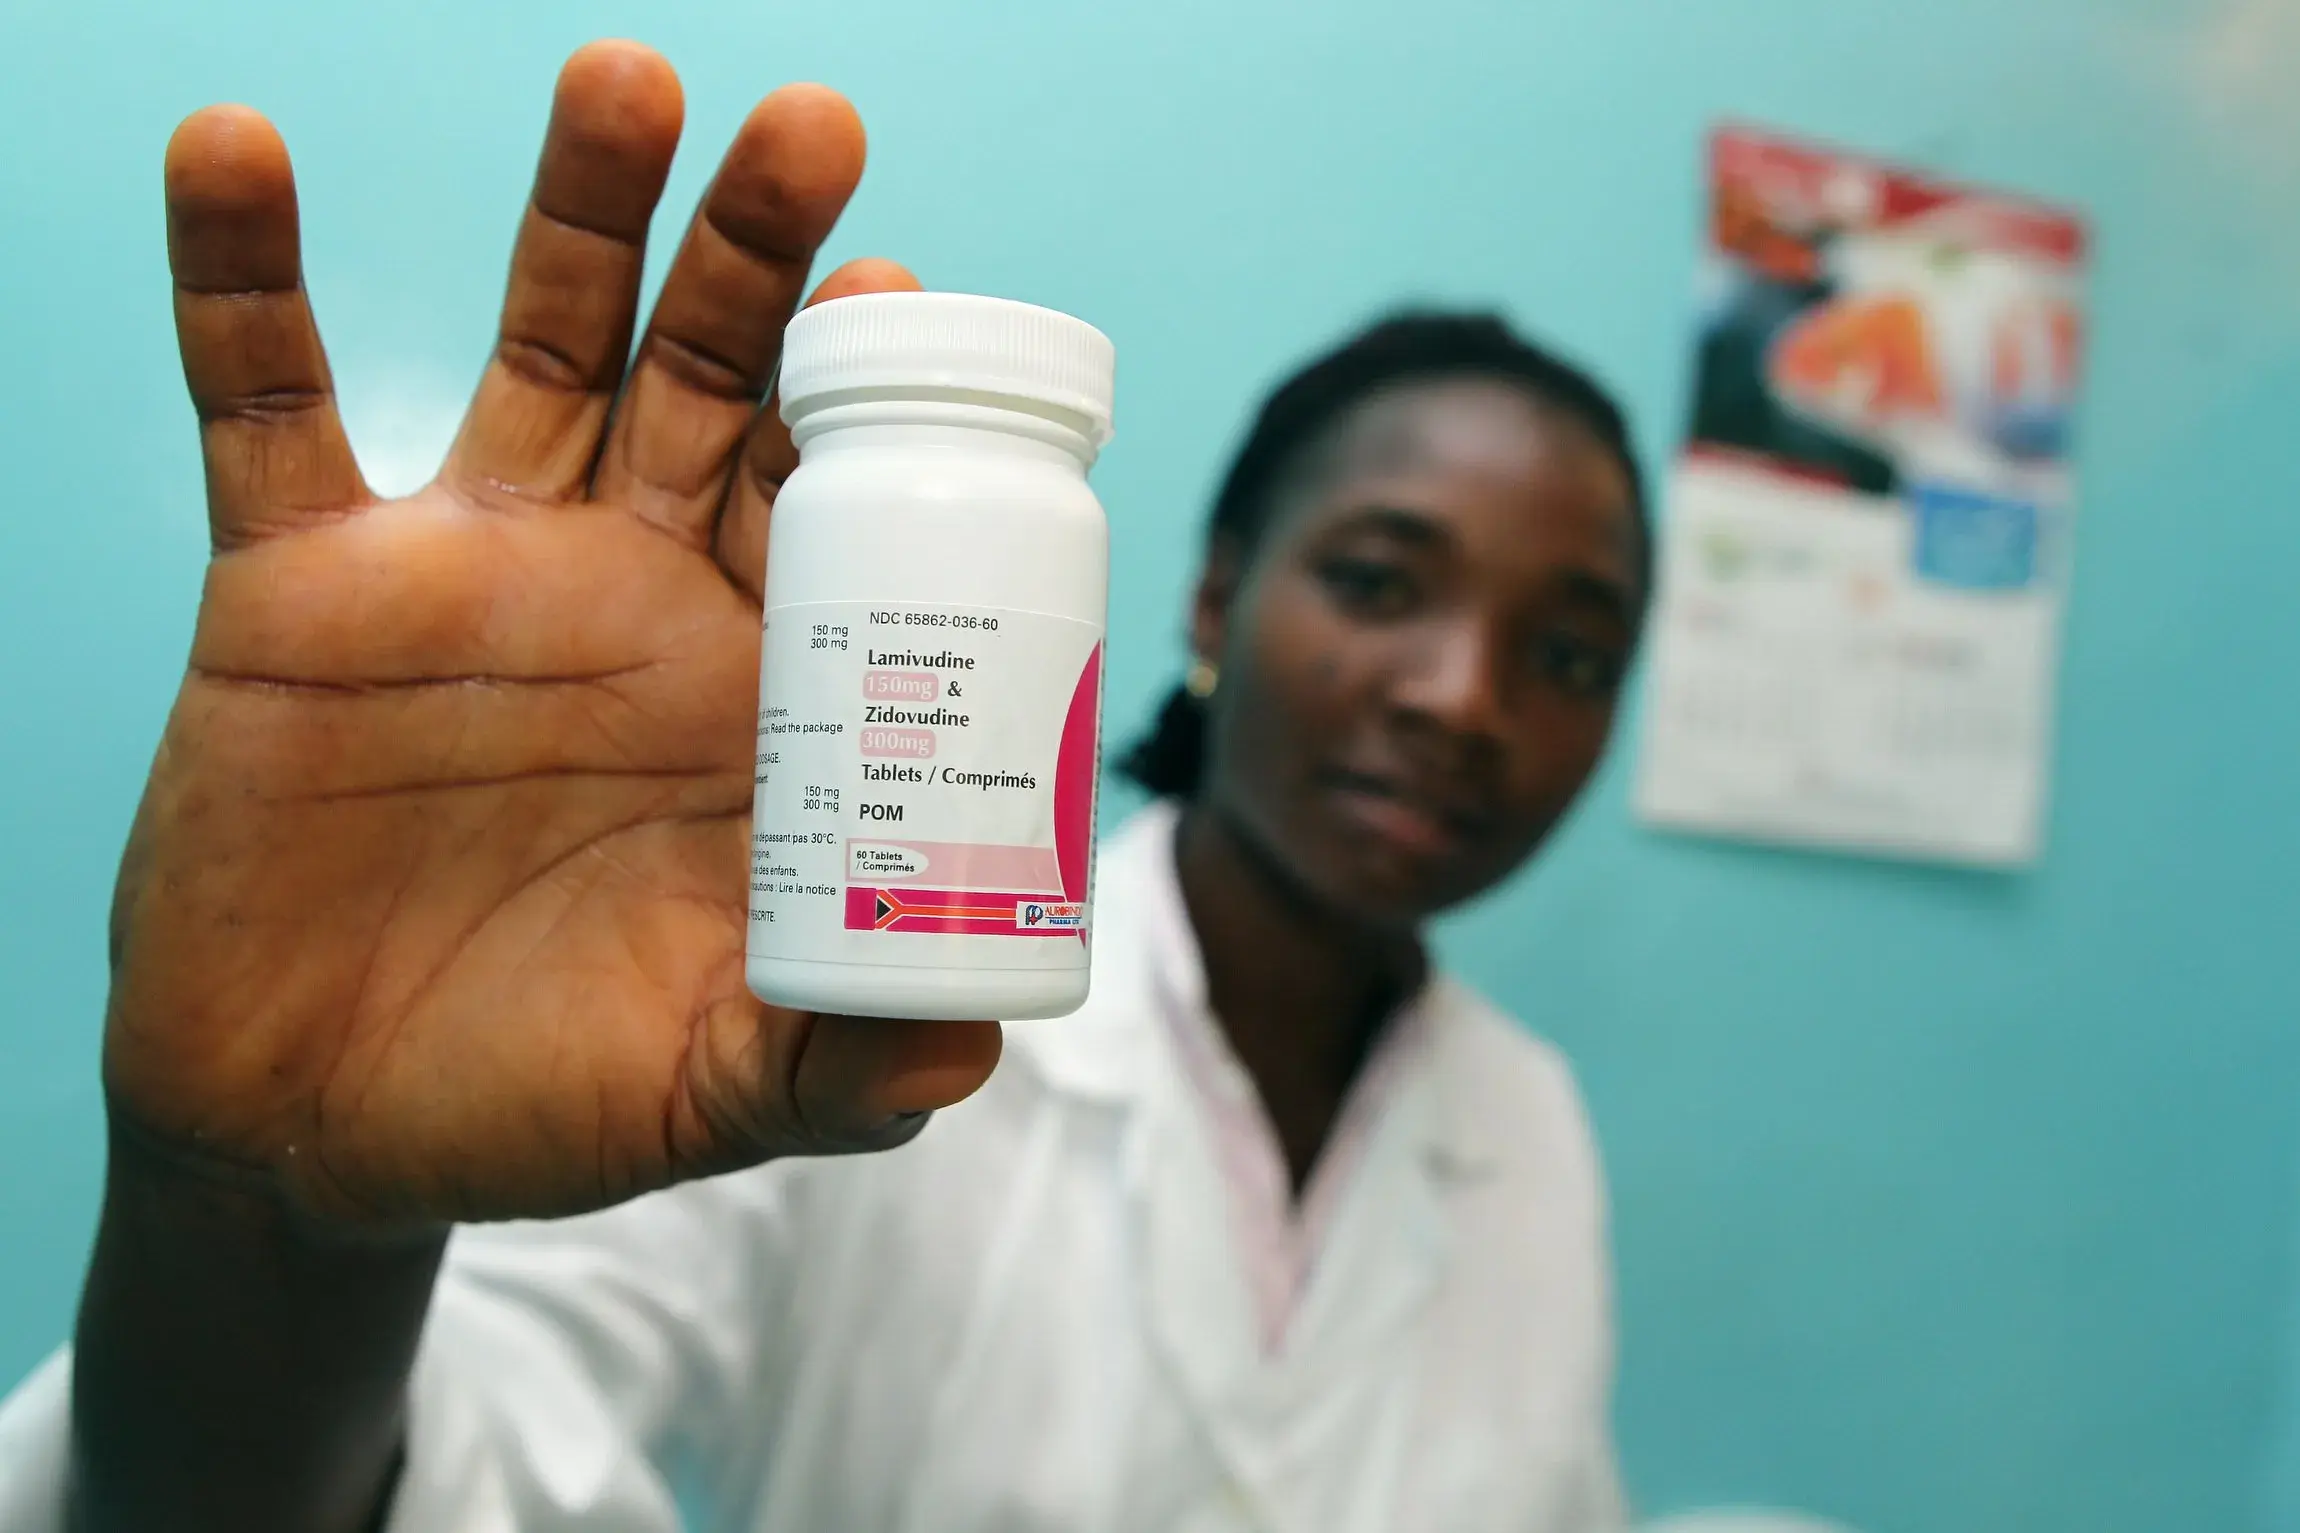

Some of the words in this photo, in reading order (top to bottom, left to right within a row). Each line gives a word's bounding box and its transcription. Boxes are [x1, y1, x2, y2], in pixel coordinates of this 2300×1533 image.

[869, 611, 901, 625] NDC
[904, 612, 999, 631] 65862-036-60
[812, 624, 829, 636] 150
[831, 626, 849, 638] mg
[810, 638, 828, 649] 300
[830, 639, 848, 651] mg
[867, 648, 976, 670] Lamivudine
[866, 675, 933, 700] 150mg
[947, 680, 963, 697] &
[863, 705, 970, 728] Zidovudine
[770, 722, 787, 734] Read
[788, 722, 801, 733] the
[802, 721, 843, 735] package
[862, 731, 931, 756] 300mg
[861, 763, 923, 782] Tablets
[927, 765, 937, 785] /
[941, 767, 1037, 791] Comprimés
[804, 785, 821, 797] 150
[823, 787, 840, 800] mg
[803, 798, 820, 810] 300
[823, 801, 839, 813] mg
[859, 803, 904, 821] POM
[792, 833, 808, 845] pas
[811, 832, 837, 845] 30°C.
[856, 850, 867, 860] 60
[869, 850, 903, 861] Tablets
[758, 865, 769, 876] des
[769, 864, 799, 877] enfants.
[862, 861, 915, 873] Comprimés
[778, 881, 794, 893] Lire
[795, 882, 803, 894] la
[805, 883, 836, 896] notice
